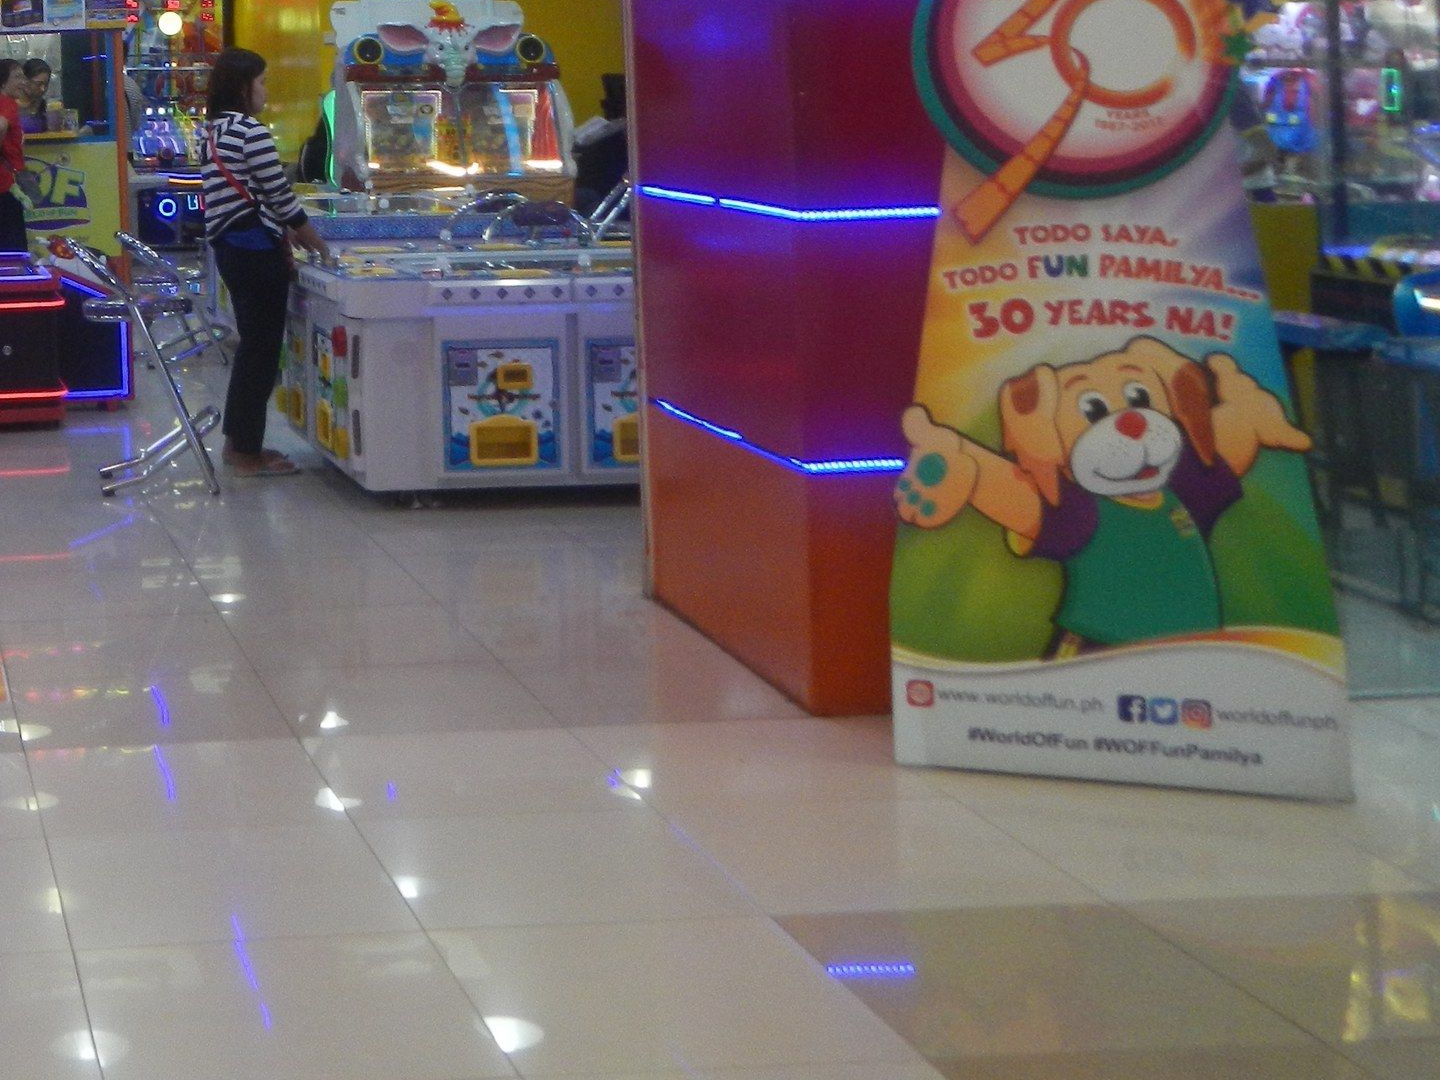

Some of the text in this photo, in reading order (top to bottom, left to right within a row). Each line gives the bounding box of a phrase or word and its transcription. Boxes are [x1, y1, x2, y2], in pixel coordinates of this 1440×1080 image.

[1013, 223, 1179, 248] TODO SAYA,
[944, 263, 1019, 290] TODO
[1027, 254, 1089, 279] FUN
[968, 298, 1235, 341] 30 YEARS NA!
